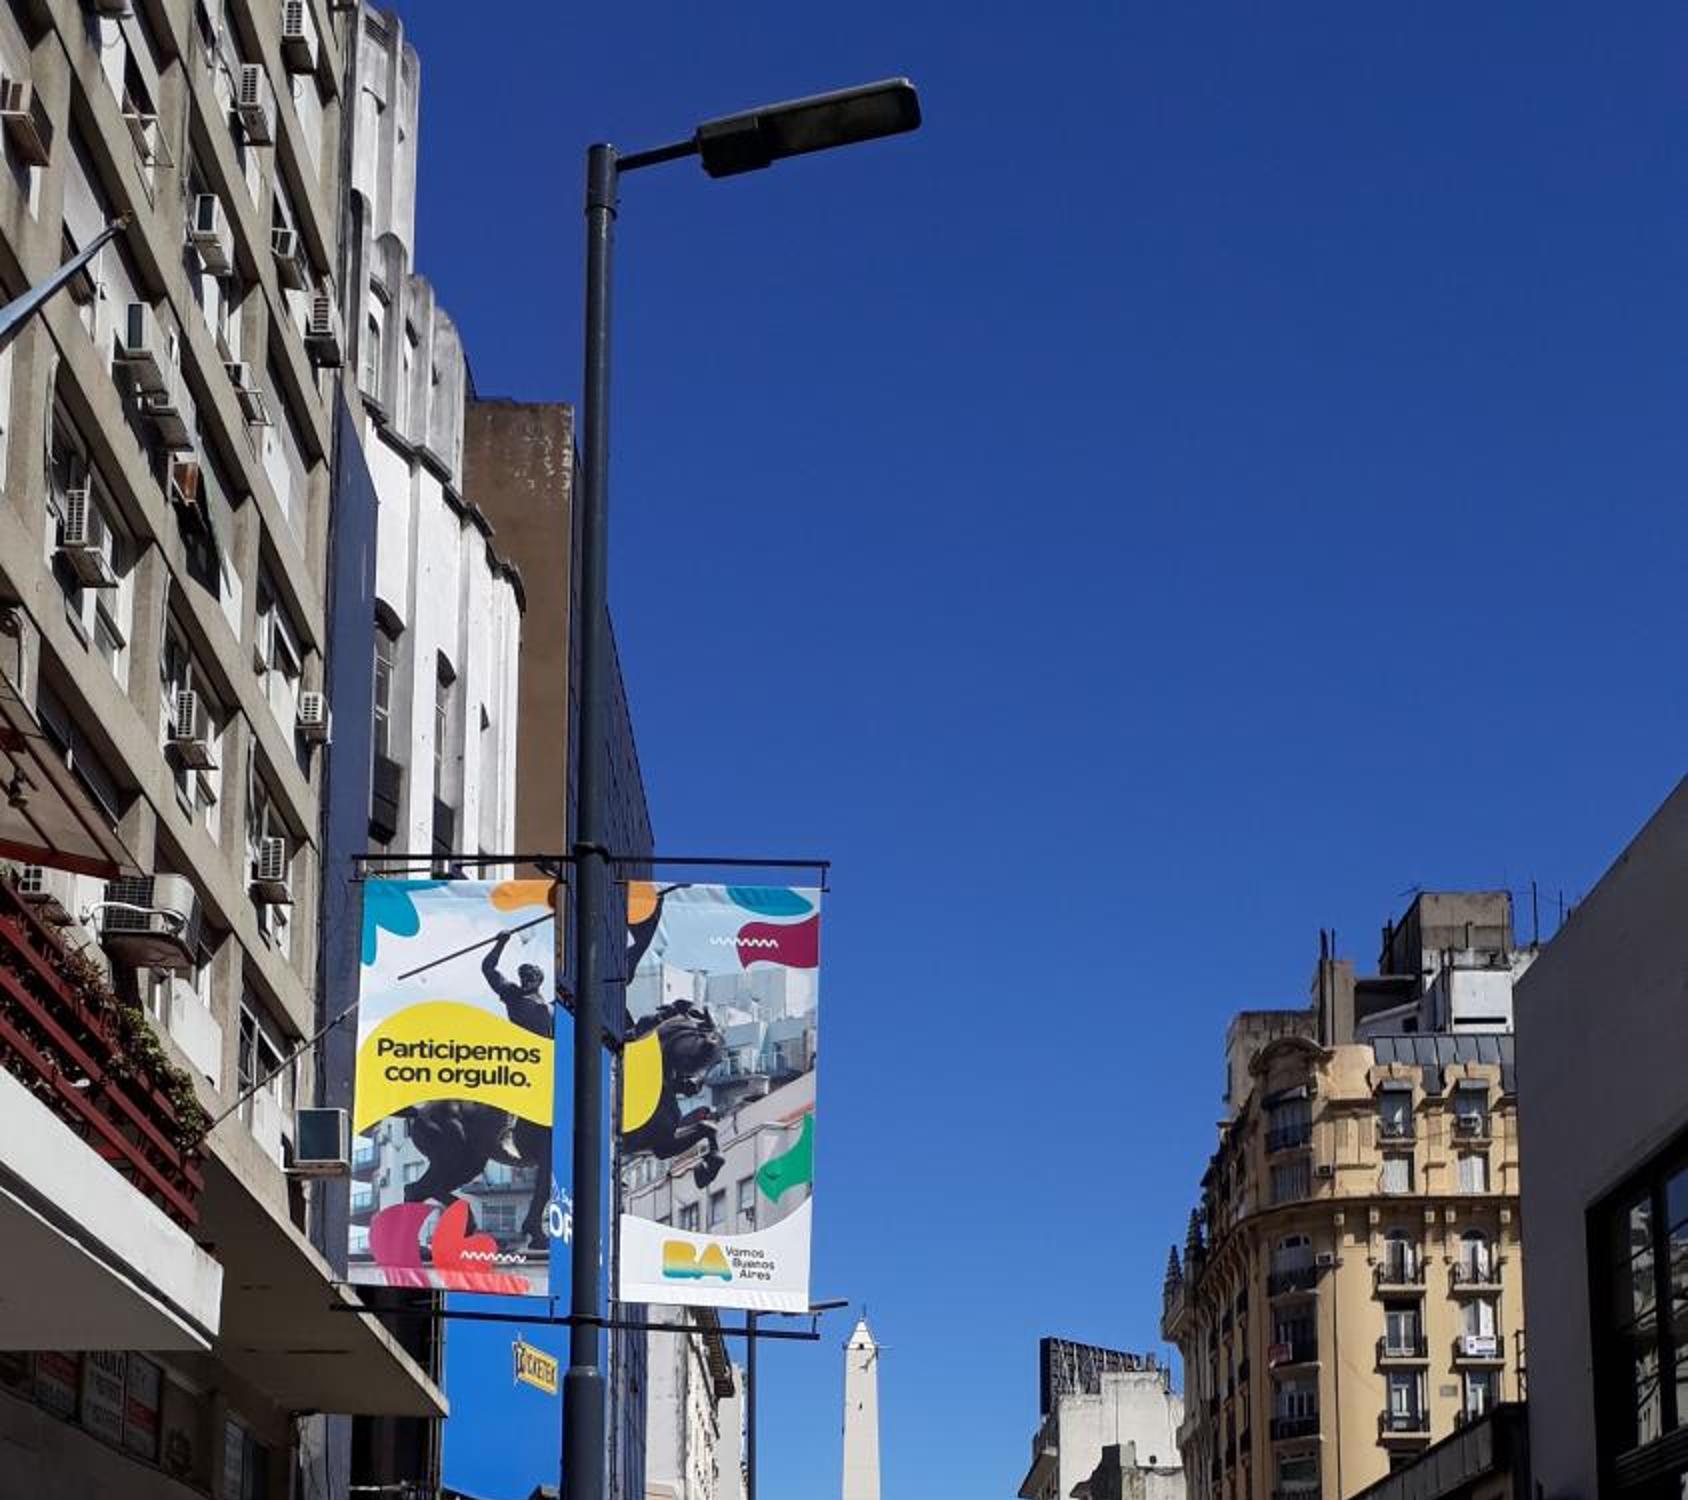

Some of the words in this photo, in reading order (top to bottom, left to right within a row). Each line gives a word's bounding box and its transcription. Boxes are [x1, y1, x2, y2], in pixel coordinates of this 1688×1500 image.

[377, 1038, 541, 1063] Participemos
[385, 1066, 431, 1083] con
[438, 1066, 531, 1089] orgullo.
[725, 1246, 765, 1259] Vamos
[732, 1258, 776, 1271] Buenos
[739, 1268, 771, 1281] Aires
